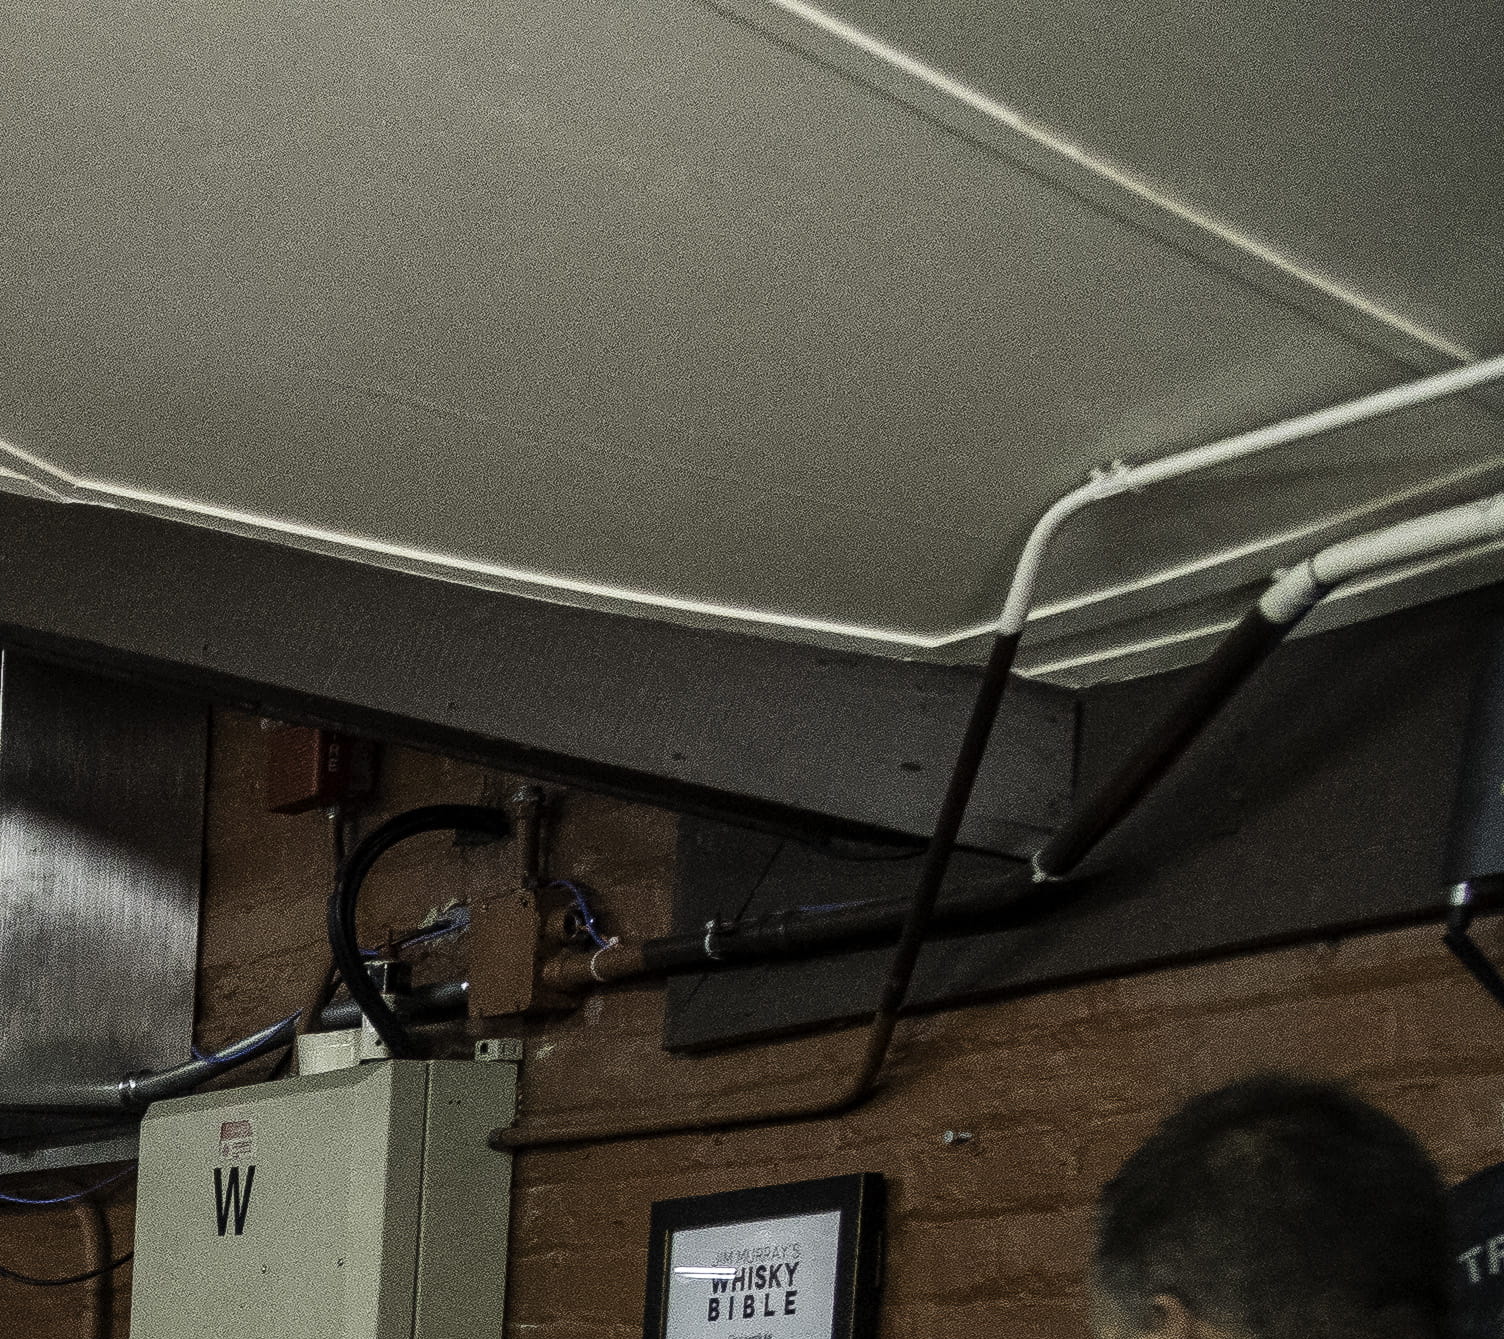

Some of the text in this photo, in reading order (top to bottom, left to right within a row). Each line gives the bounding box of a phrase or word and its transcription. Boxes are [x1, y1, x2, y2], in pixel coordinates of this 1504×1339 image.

[213, 1165, 256, 1237] W
[712, 1261, 800, 1294] WHISKY
[708, 1291, 797, 1321] BIBLE
